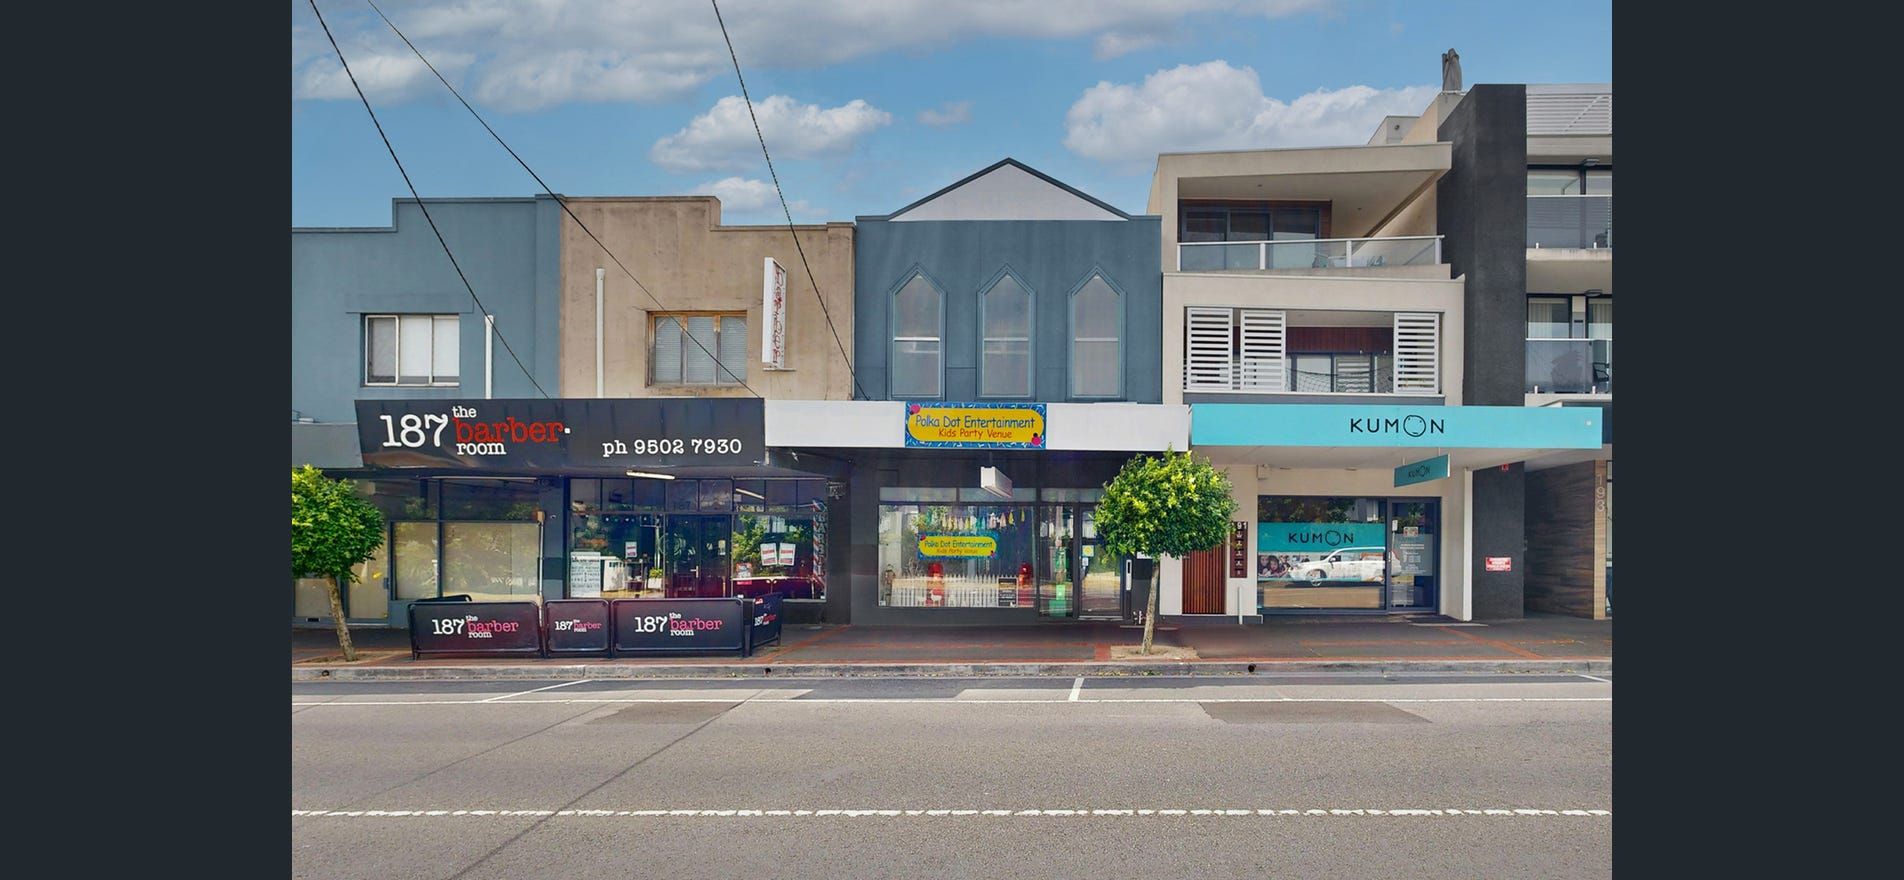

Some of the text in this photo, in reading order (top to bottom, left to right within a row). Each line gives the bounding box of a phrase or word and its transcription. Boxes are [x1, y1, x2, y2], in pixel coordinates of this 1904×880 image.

[452, 405, 477, 418] the
[916, 415, 1035, 428] Polka Dot Entertainment
[1350, 415, 1444, 437] KUMON
[379, 413, 449, 448] 187
[938, 428, 1012, 440] Kids Party Venue
[456, 442, 507, 455] room
[602, 438, 742, 457] ph 9502 7930
[1408, 465, 1431, 478] KUMON
[1596, 473, 1606, 511] 193
[941, 540, 951, 548] Dot
[953, 540, 993, 548] Entertainment
[1288, 530, 1354, 546] KUMON
[431, 618, 519, 635] 187 barber
[554, 620, 573, 631] 187
[634, 615, 722, 632] 187 barber
